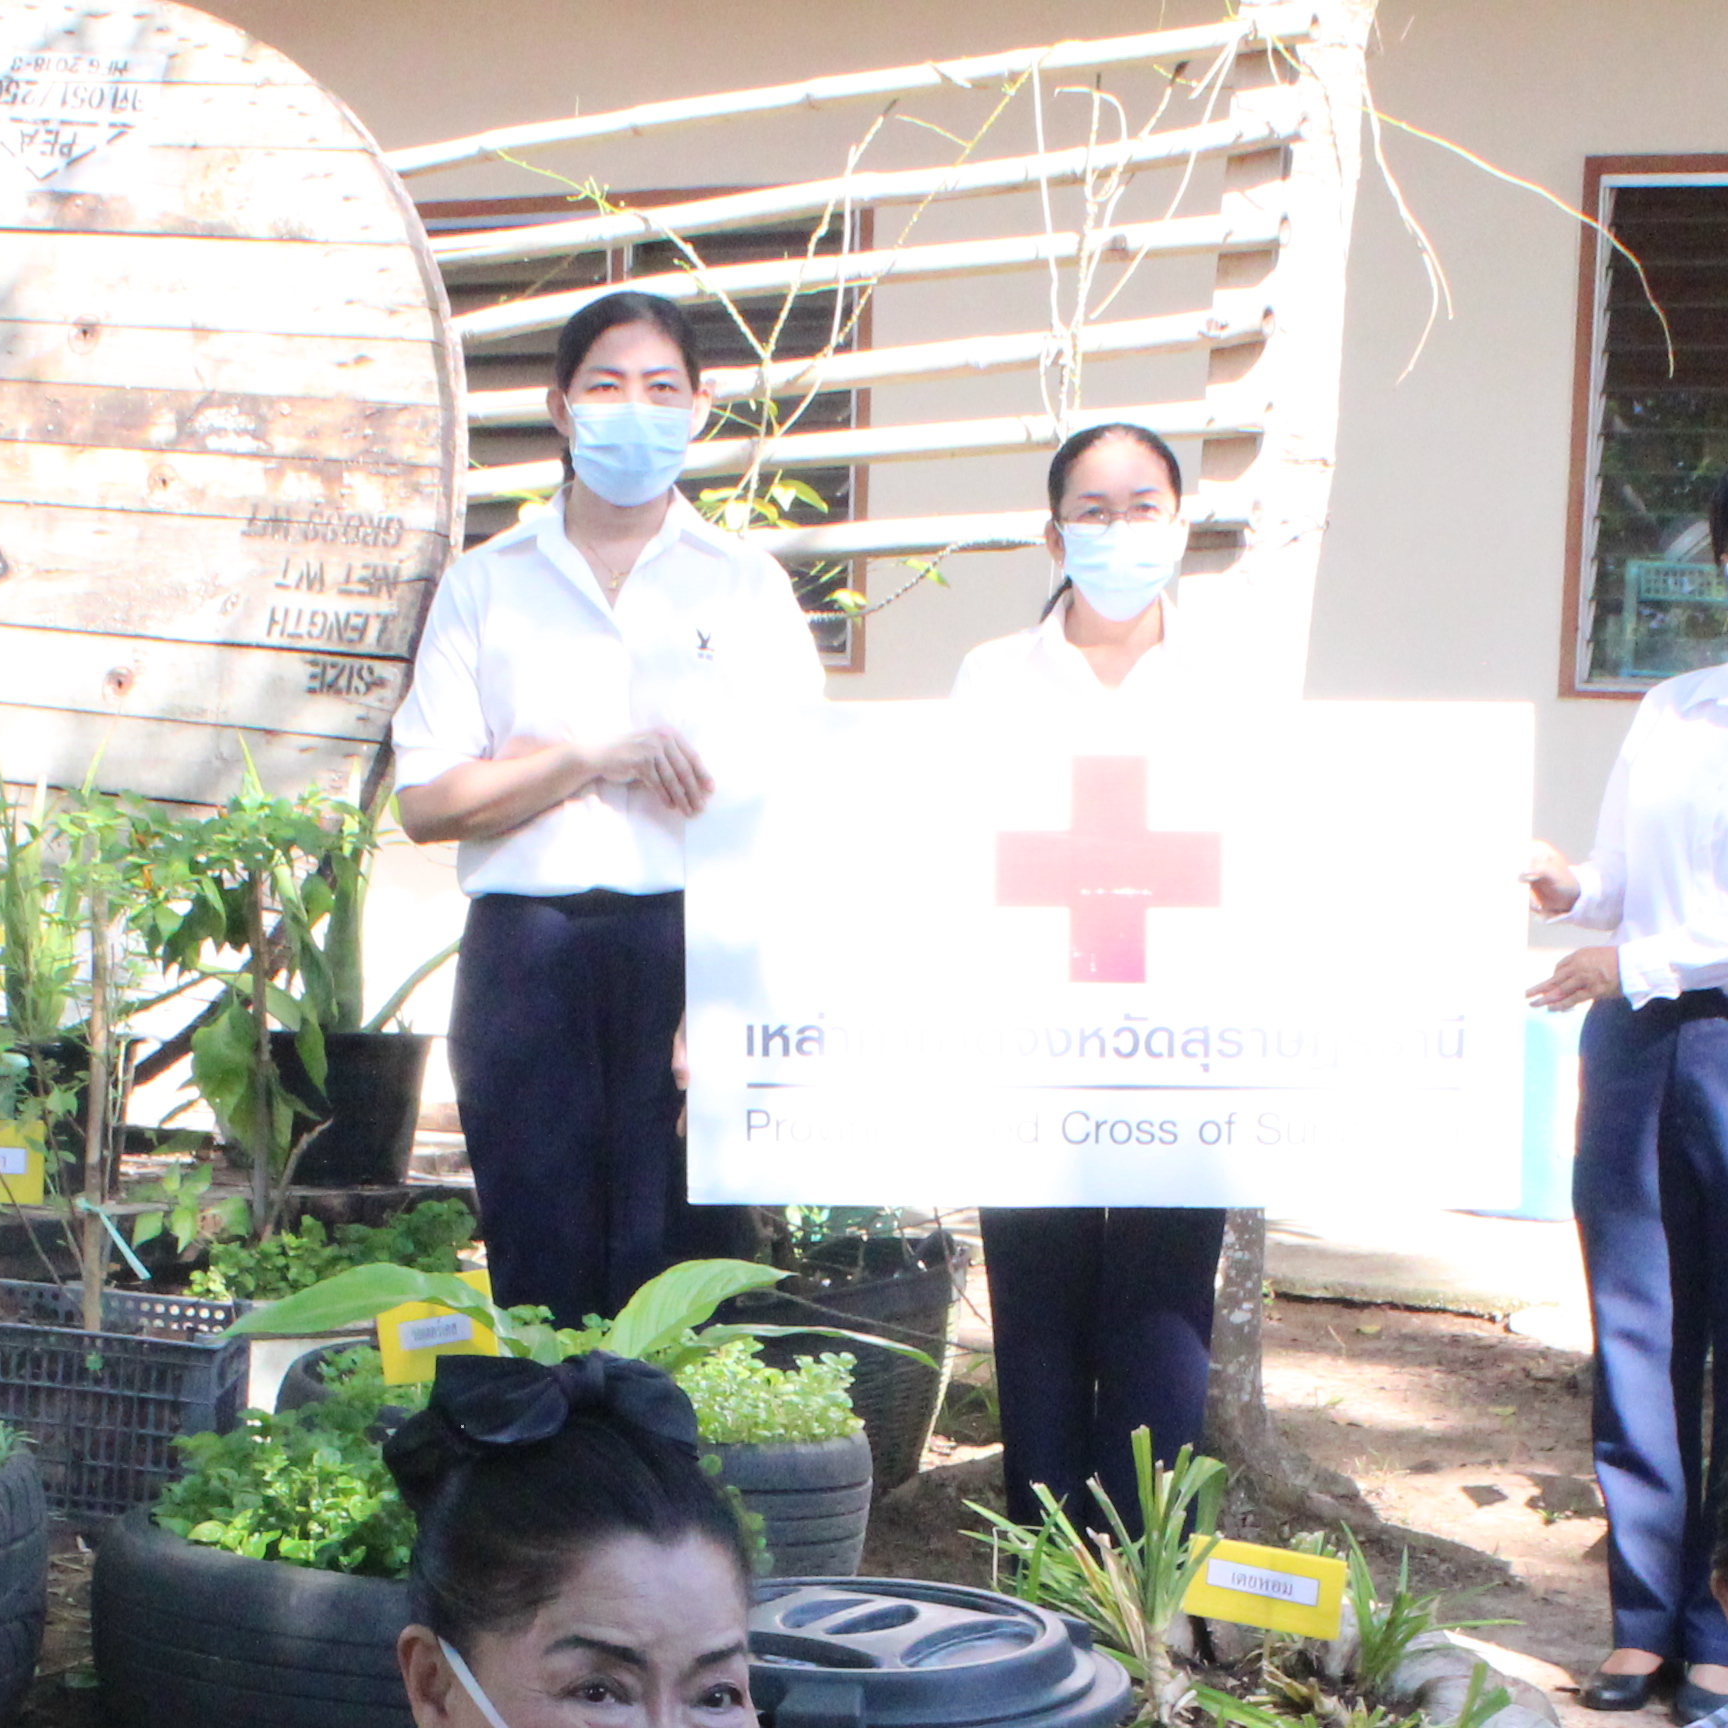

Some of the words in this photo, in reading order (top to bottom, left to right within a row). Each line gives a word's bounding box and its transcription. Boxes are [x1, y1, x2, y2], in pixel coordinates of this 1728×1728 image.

[19, 129, 77, 158] PEA
[274, 559, 325, 594] WT
[337, 562, 400, 599] NET
[266, 606, 395, 648] LENGTH
[1060, 1110, 1179, 1146] Cross
[1196, 1111, 1239, 1146] of
